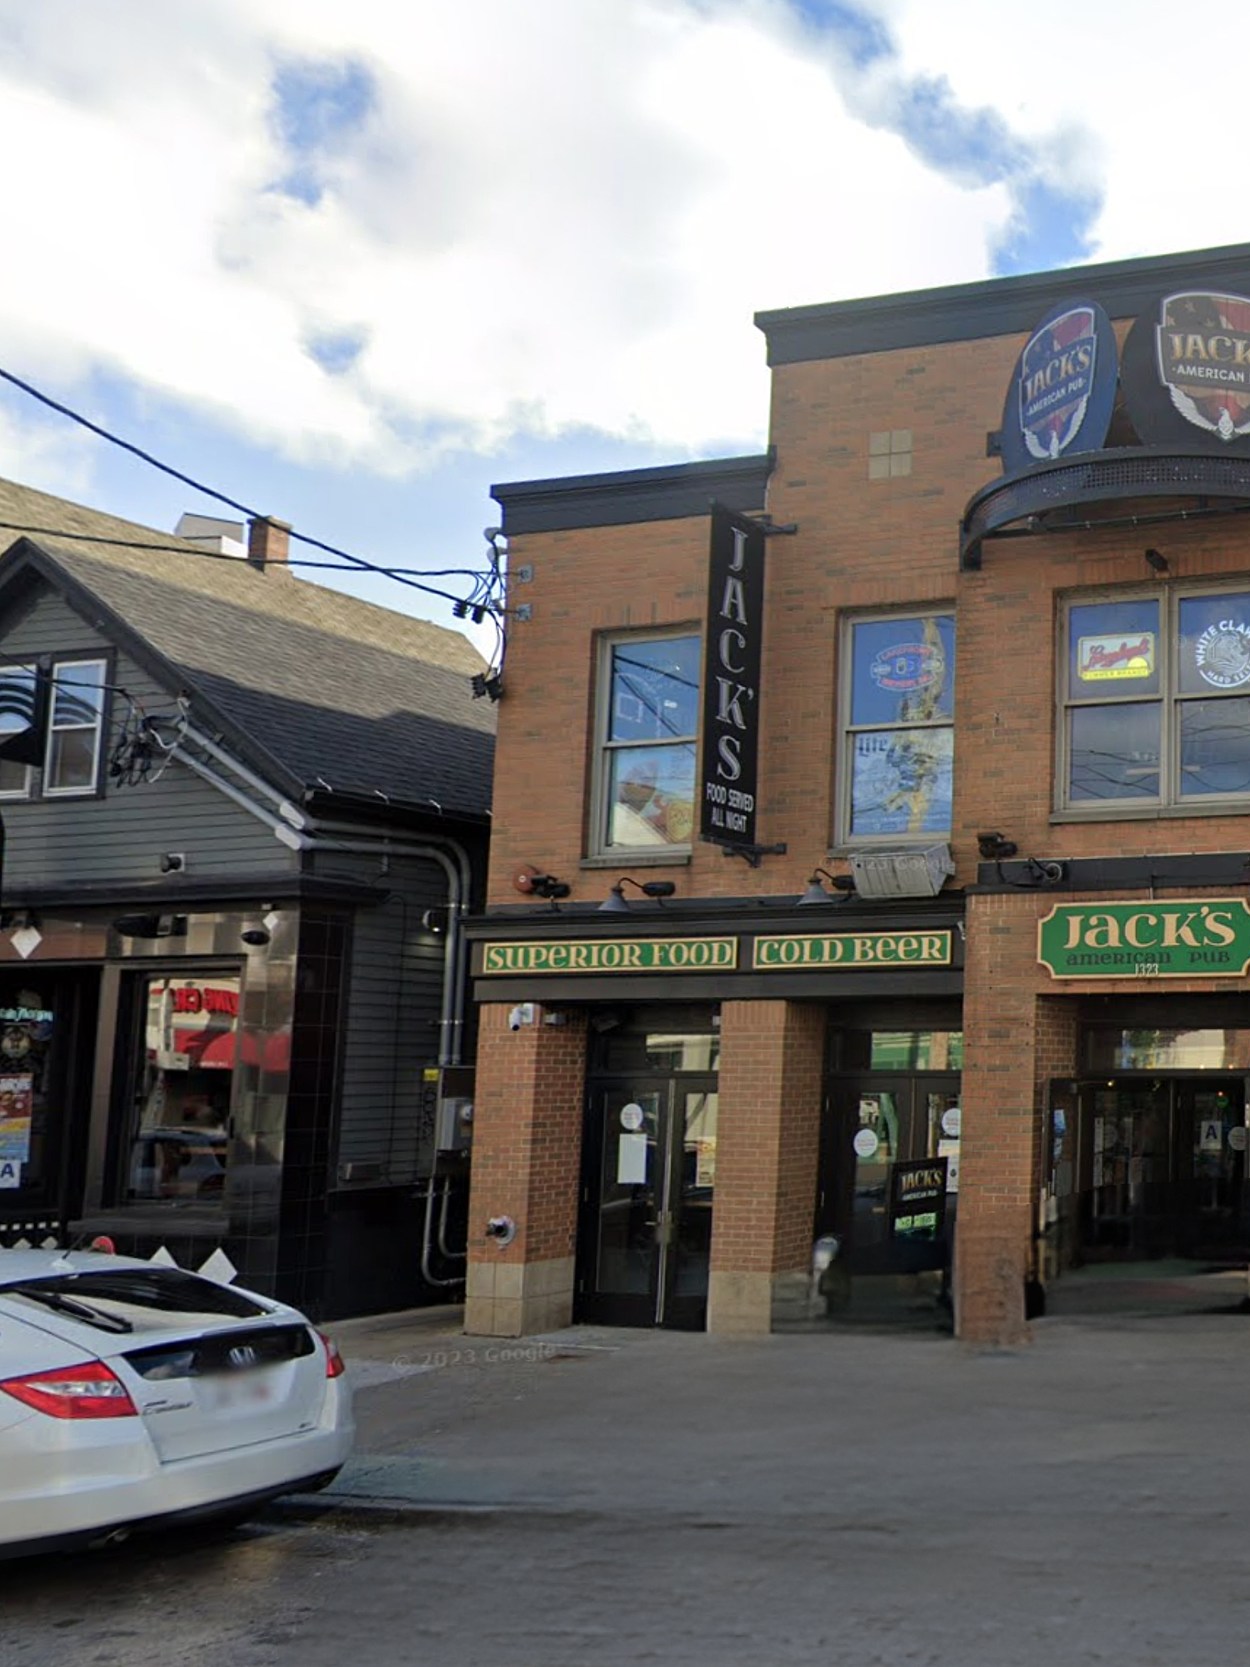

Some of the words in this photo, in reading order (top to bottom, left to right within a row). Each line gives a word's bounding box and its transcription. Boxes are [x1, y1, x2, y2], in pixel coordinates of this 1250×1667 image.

[1025, 345, 1091, 404] JACK'S
[1177, 364, 1245, 384] AMERICAN
[1028, 386, 1066, 415] AMERICAN
[1068, 377, 1084, 393] PUB
[716, 526, 753, 781] JACK'S
[1195, 624, 1218, 667] WHITE
[706, 782, 727, 804] FOOD
[728, 789, 754, 813] SERVED
[711, 806, 724, 827] ALL
[651, 941, 732, 967] FOOD
[759, 938, 844, 964] COLD
[1205, 1125, 1217, 1139] A
[1, 1163, 14, 1178] A
[902, 1168, 943, 1191] JACK'S
